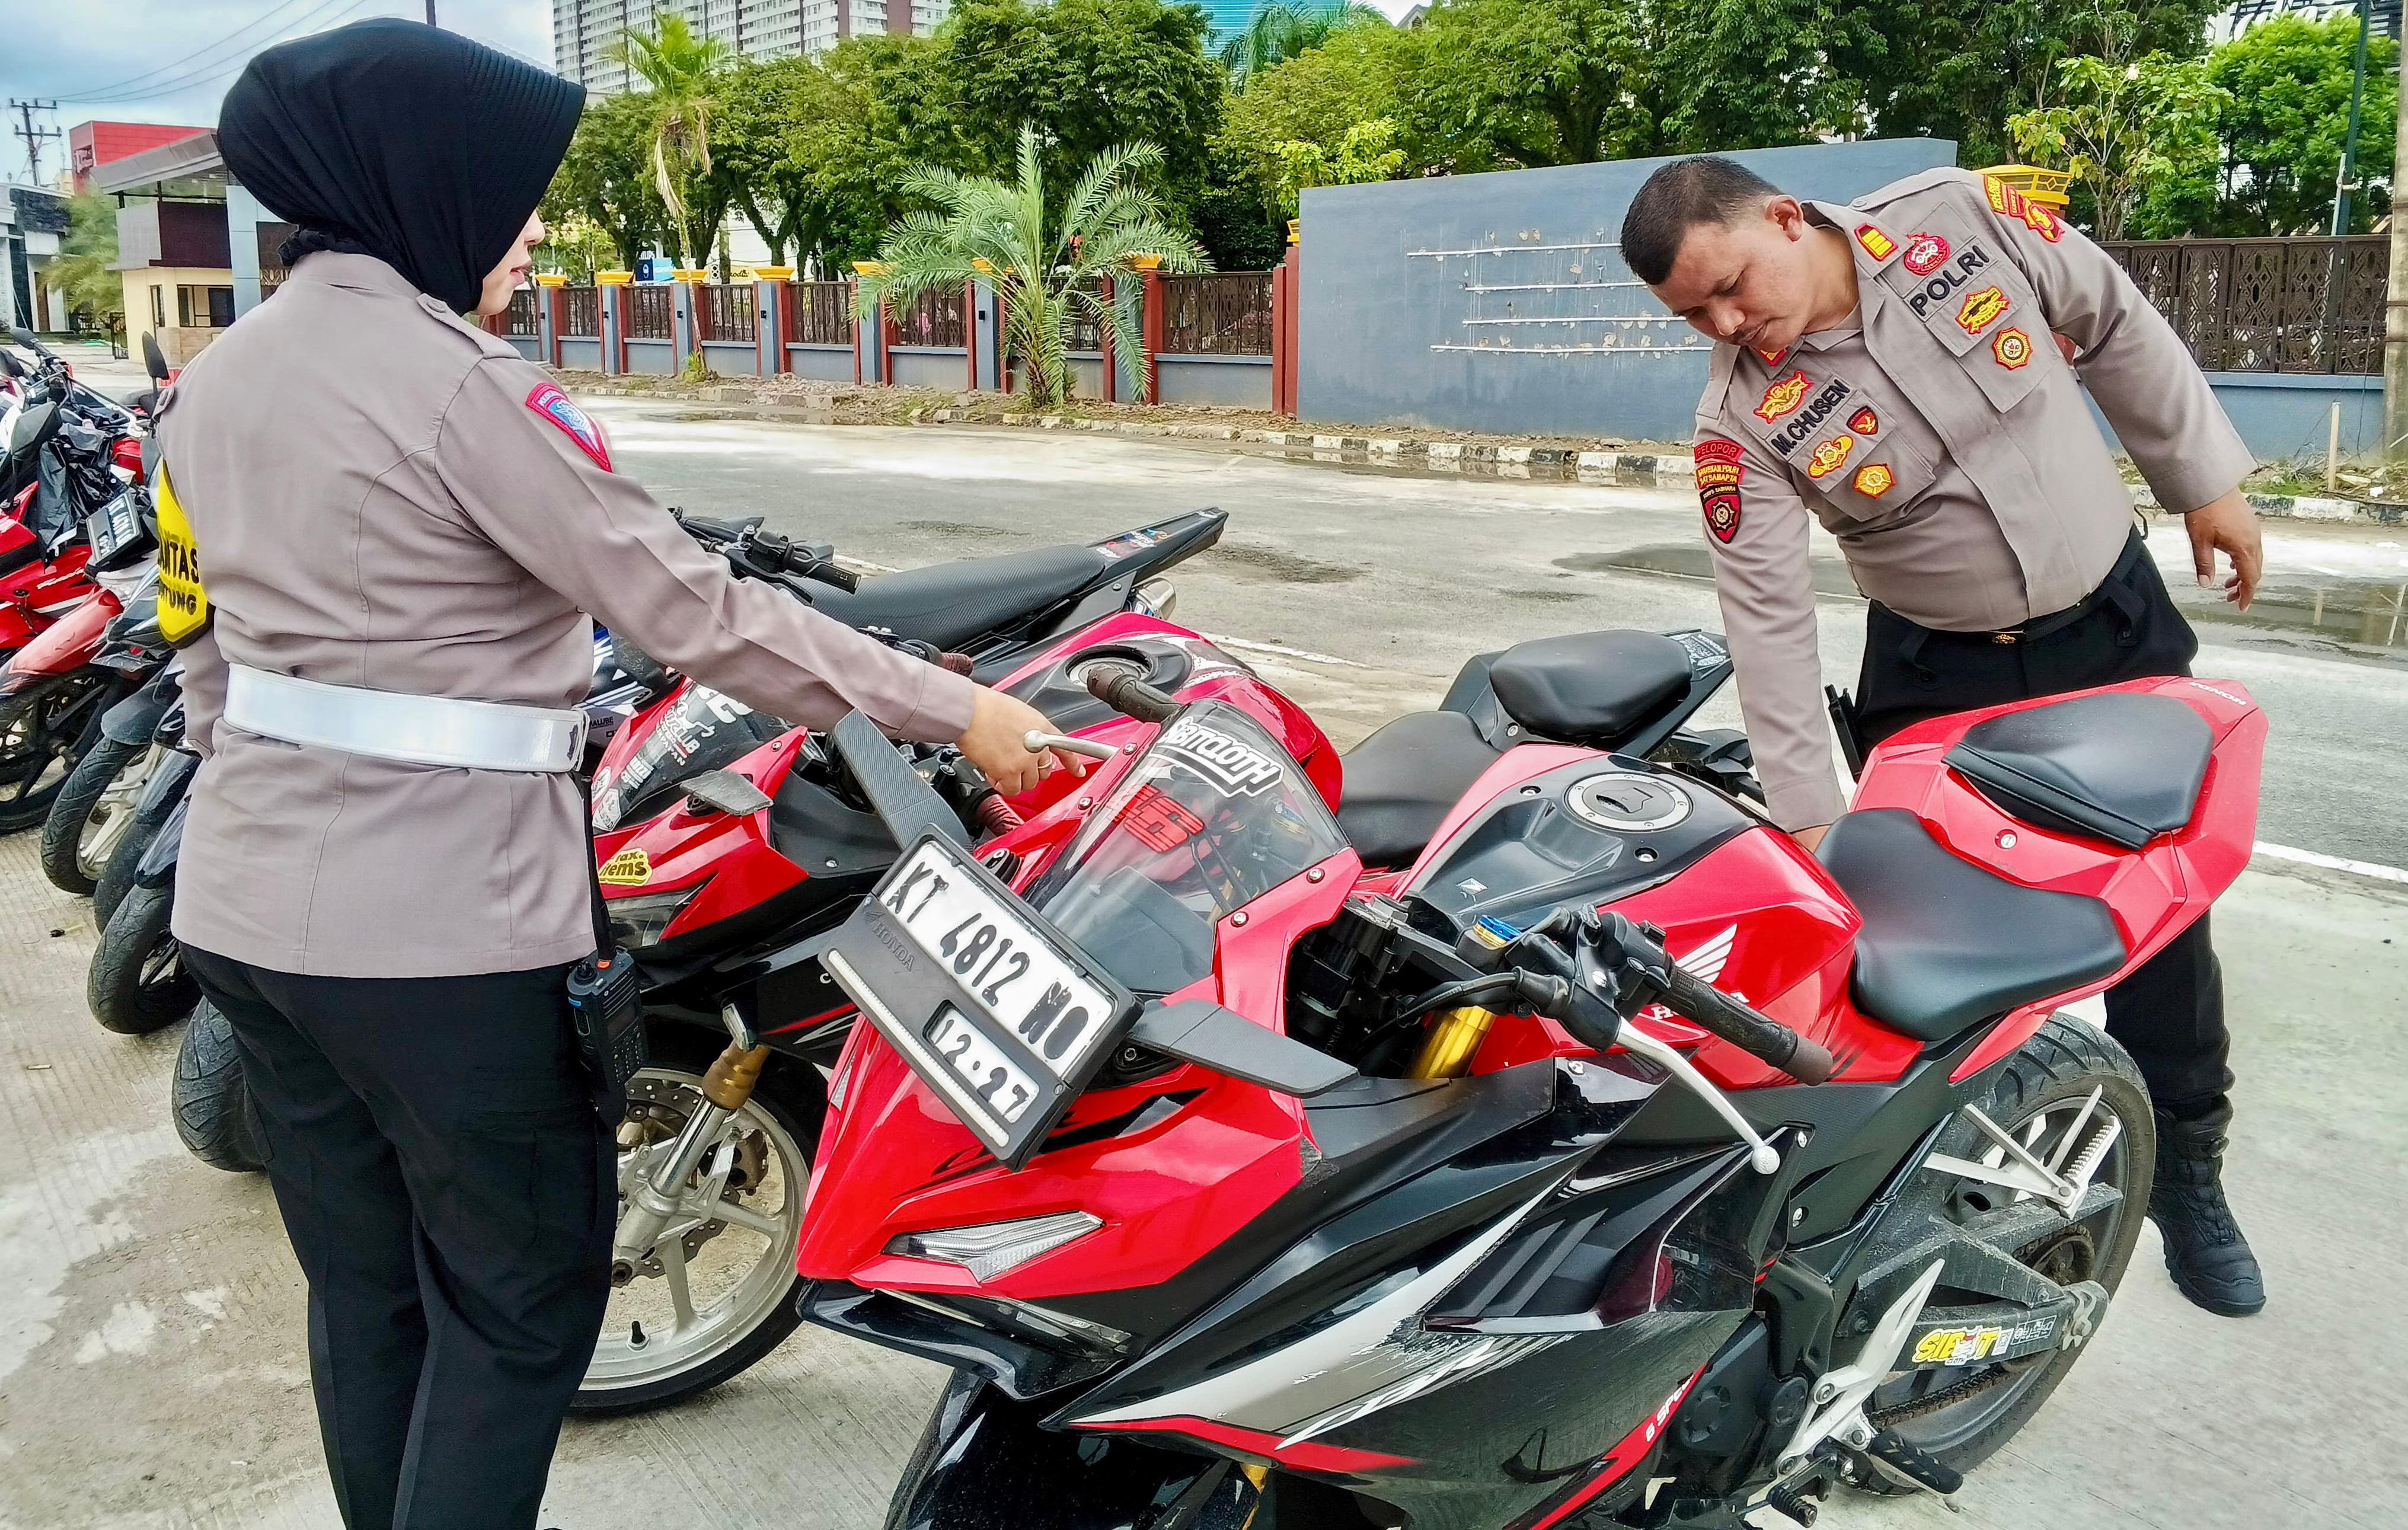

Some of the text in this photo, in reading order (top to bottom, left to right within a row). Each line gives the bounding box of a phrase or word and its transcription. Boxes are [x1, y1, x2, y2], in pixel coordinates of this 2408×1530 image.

[1909, 245, 1989, 317] POLRI
[1771, 379, 1850, 455] M.CHUSEN
[872, 922, 914, 972] HONDA
[887, 861, 949, 924] KT
[940, 913, 1030, 1007] 4812
[1646, 1422, 1655, 1442] 6
